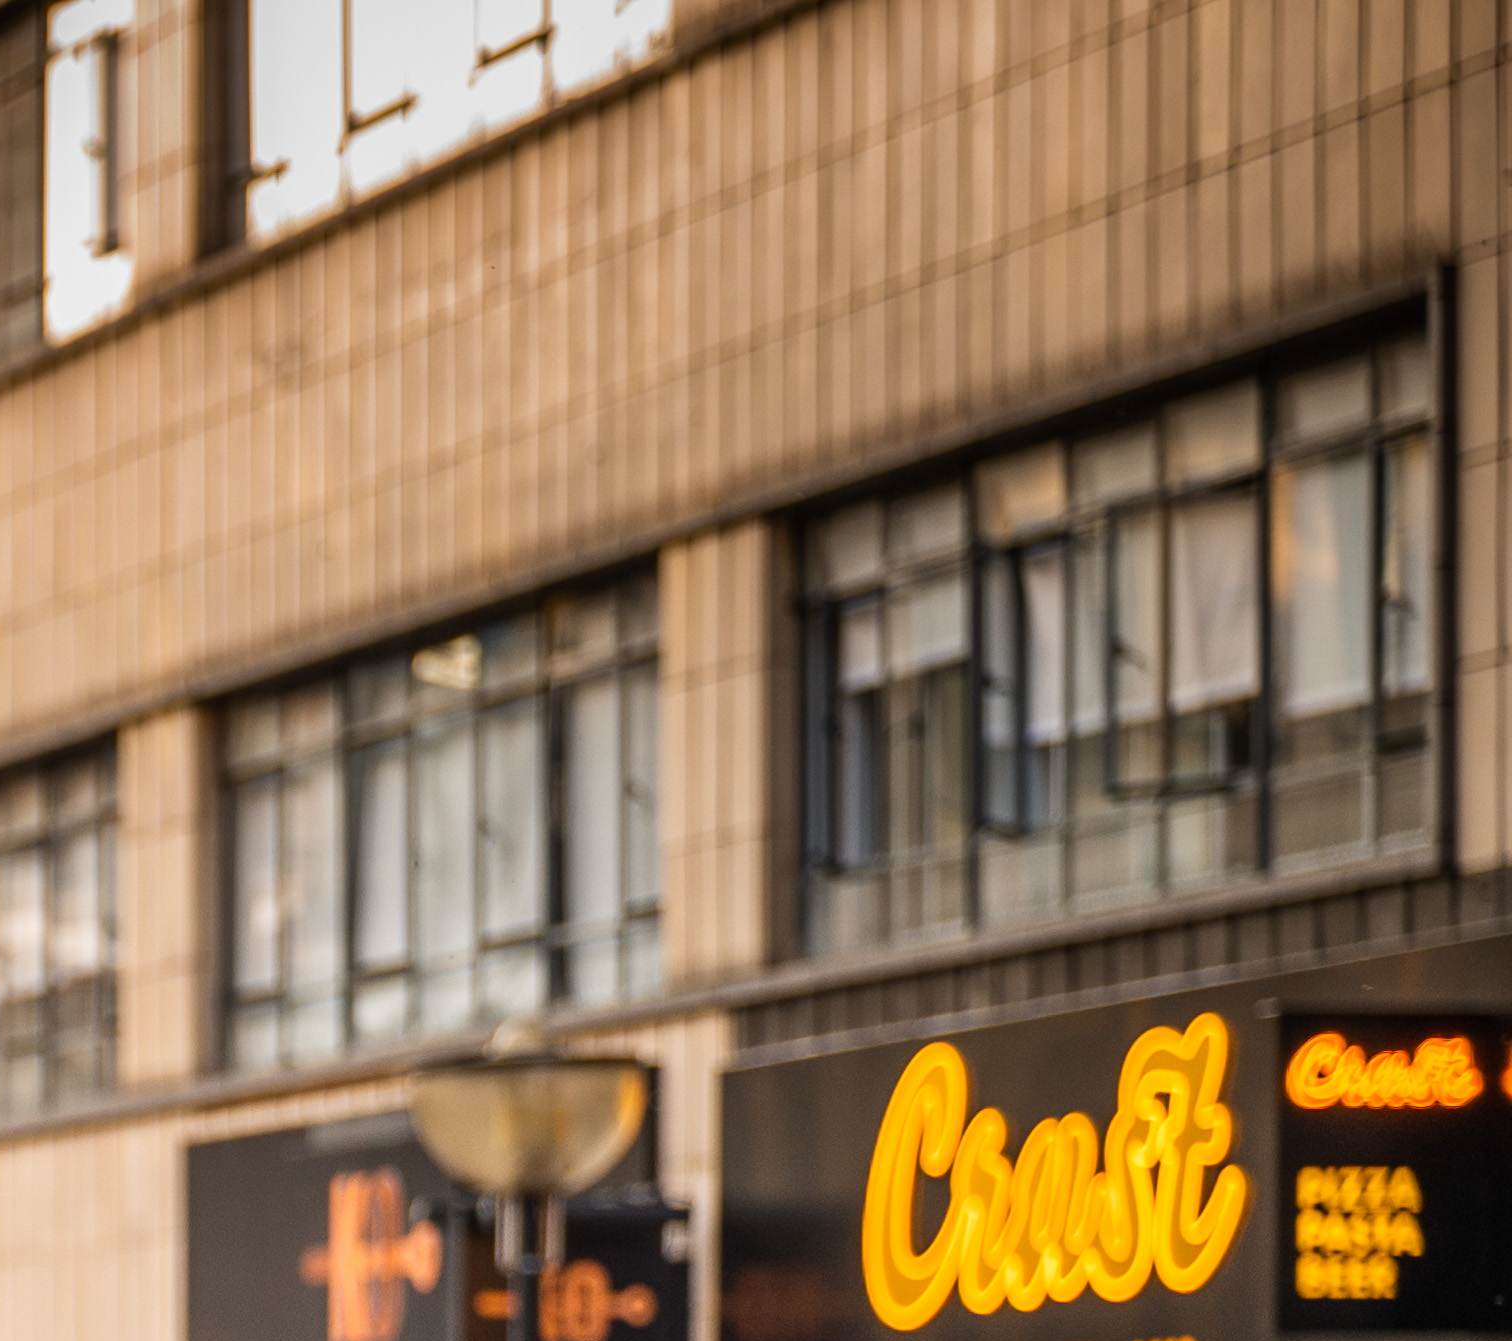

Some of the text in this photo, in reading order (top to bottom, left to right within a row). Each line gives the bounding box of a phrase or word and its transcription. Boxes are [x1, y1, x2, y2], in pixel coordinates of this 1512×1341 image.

[1285, 1031, 1485, 1109] Crust
[862, 1012, 1247, 1331] Crust
[1296, 1166, 1423, 1212] PIZZA
[1295, 1210, 1425, 1257] PASTA
[1295, 1253, 1399, 1300] BEER
